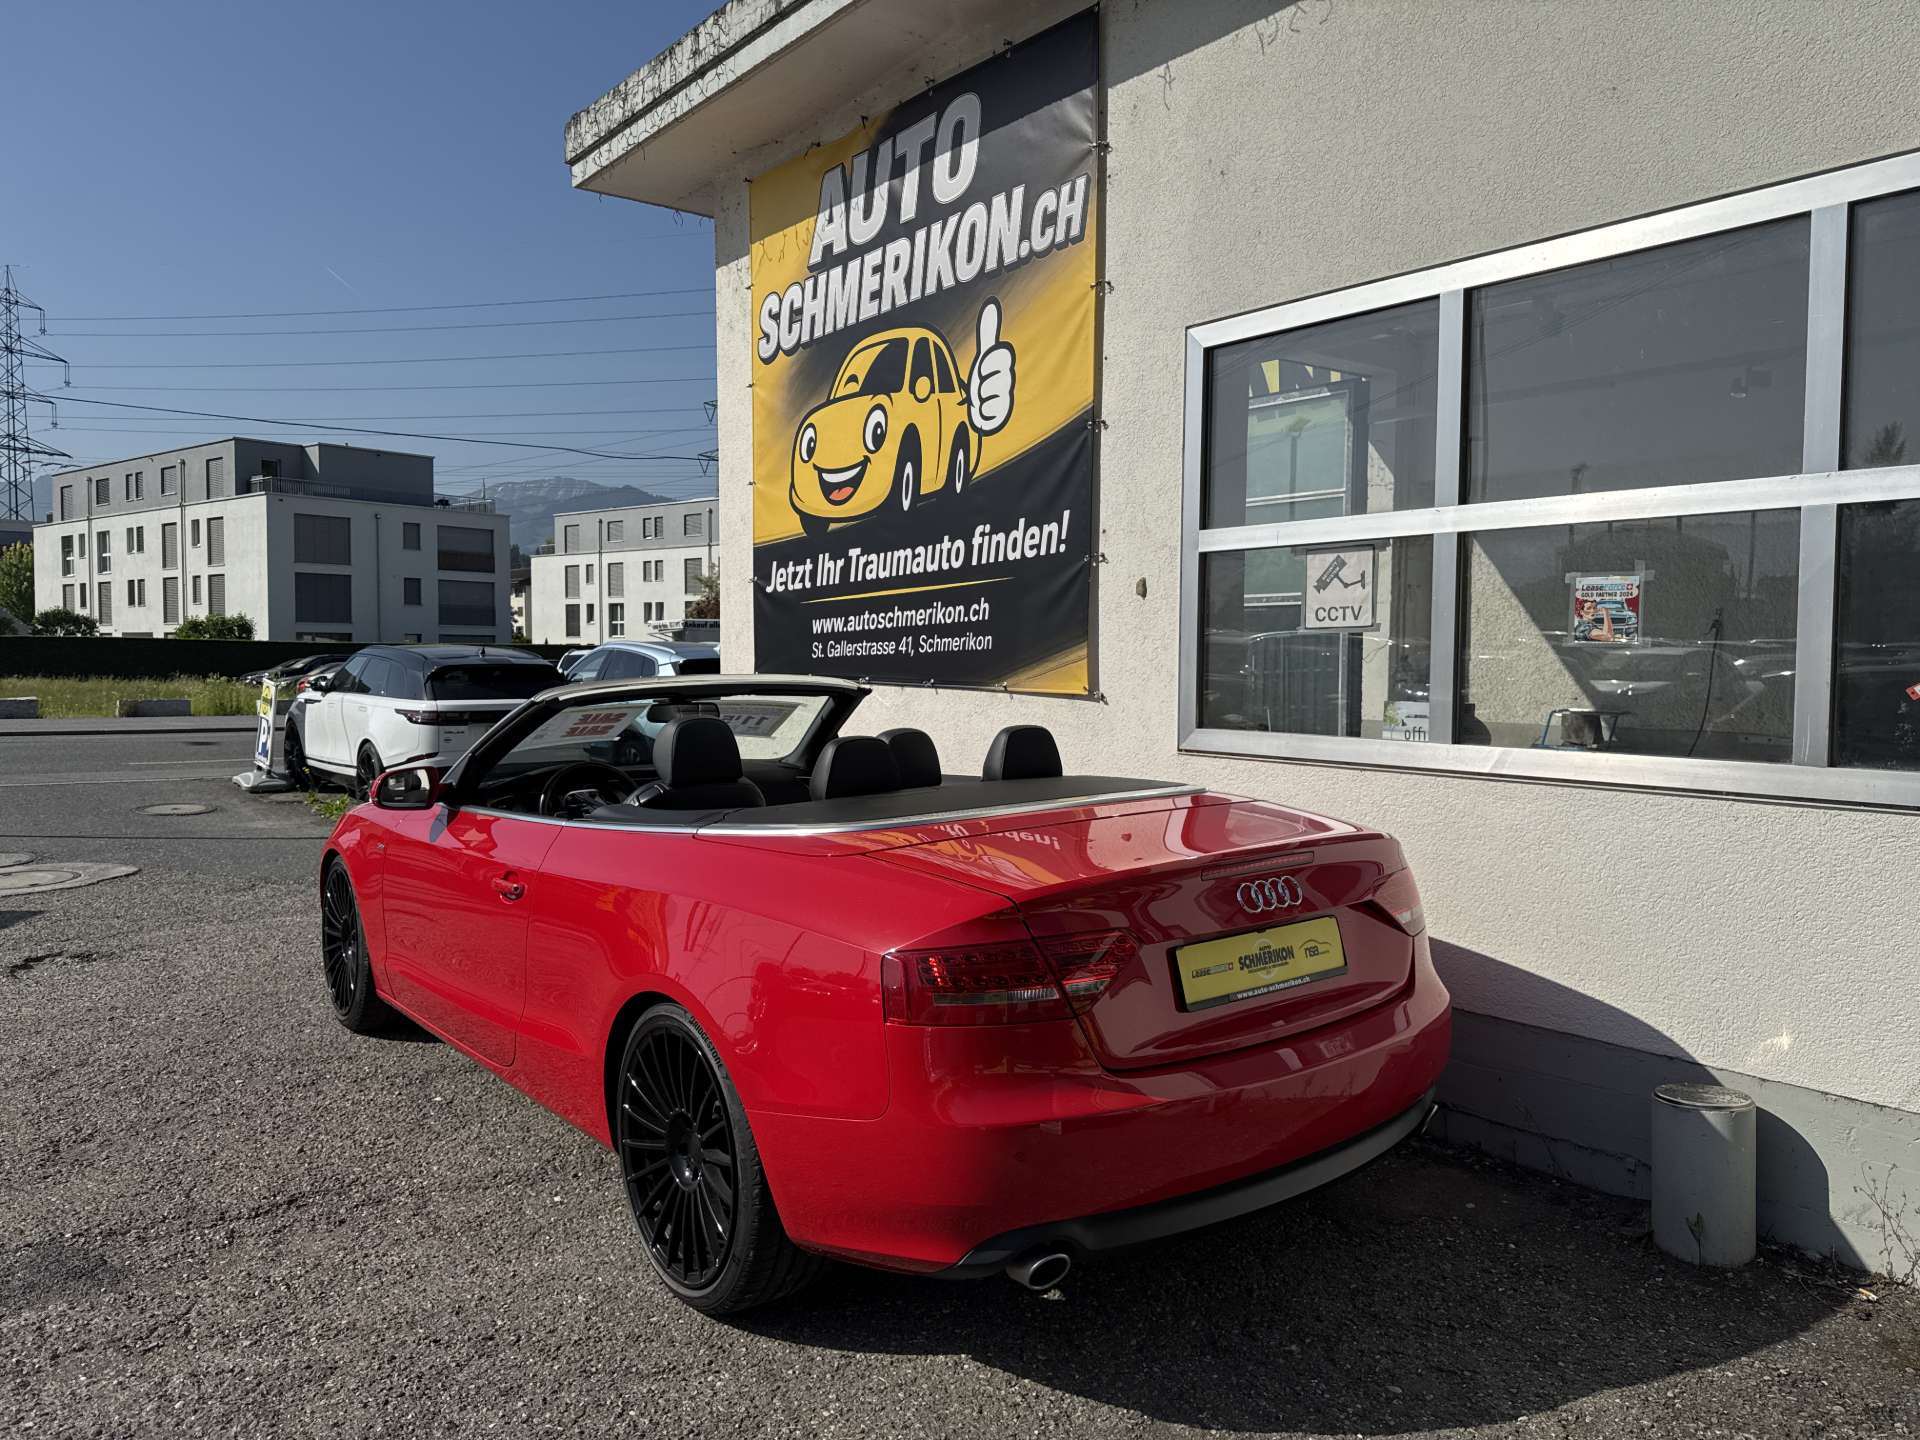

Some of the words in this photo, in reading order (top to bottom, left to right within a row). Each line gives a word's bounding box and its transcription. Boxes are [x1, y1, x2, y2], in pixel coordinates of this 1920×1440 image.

[808, 92, 982, 267] AUTO
[758, 175, 1089, 361] SCHMERIKON.CH
[766, 561, 812, 594] Jetzt
[816, 553, 844, 588] Ihr
[848, 535, 965, 583] Traumauto
[971, 509, 1071, 565] finden!
[812, 598, 989, 635] www.autoschmerikon.ch
[1314, 606, 1363, 623] CCTV
[812, 642, 825, 659] St.
[827, 638, 896, 658] Gallerstrasse
[898, 636, 915, 657] 41,
[918, 632, 993, 654] Schmerikon
[1238, 945, 1295, 971] SCHMERIKON
